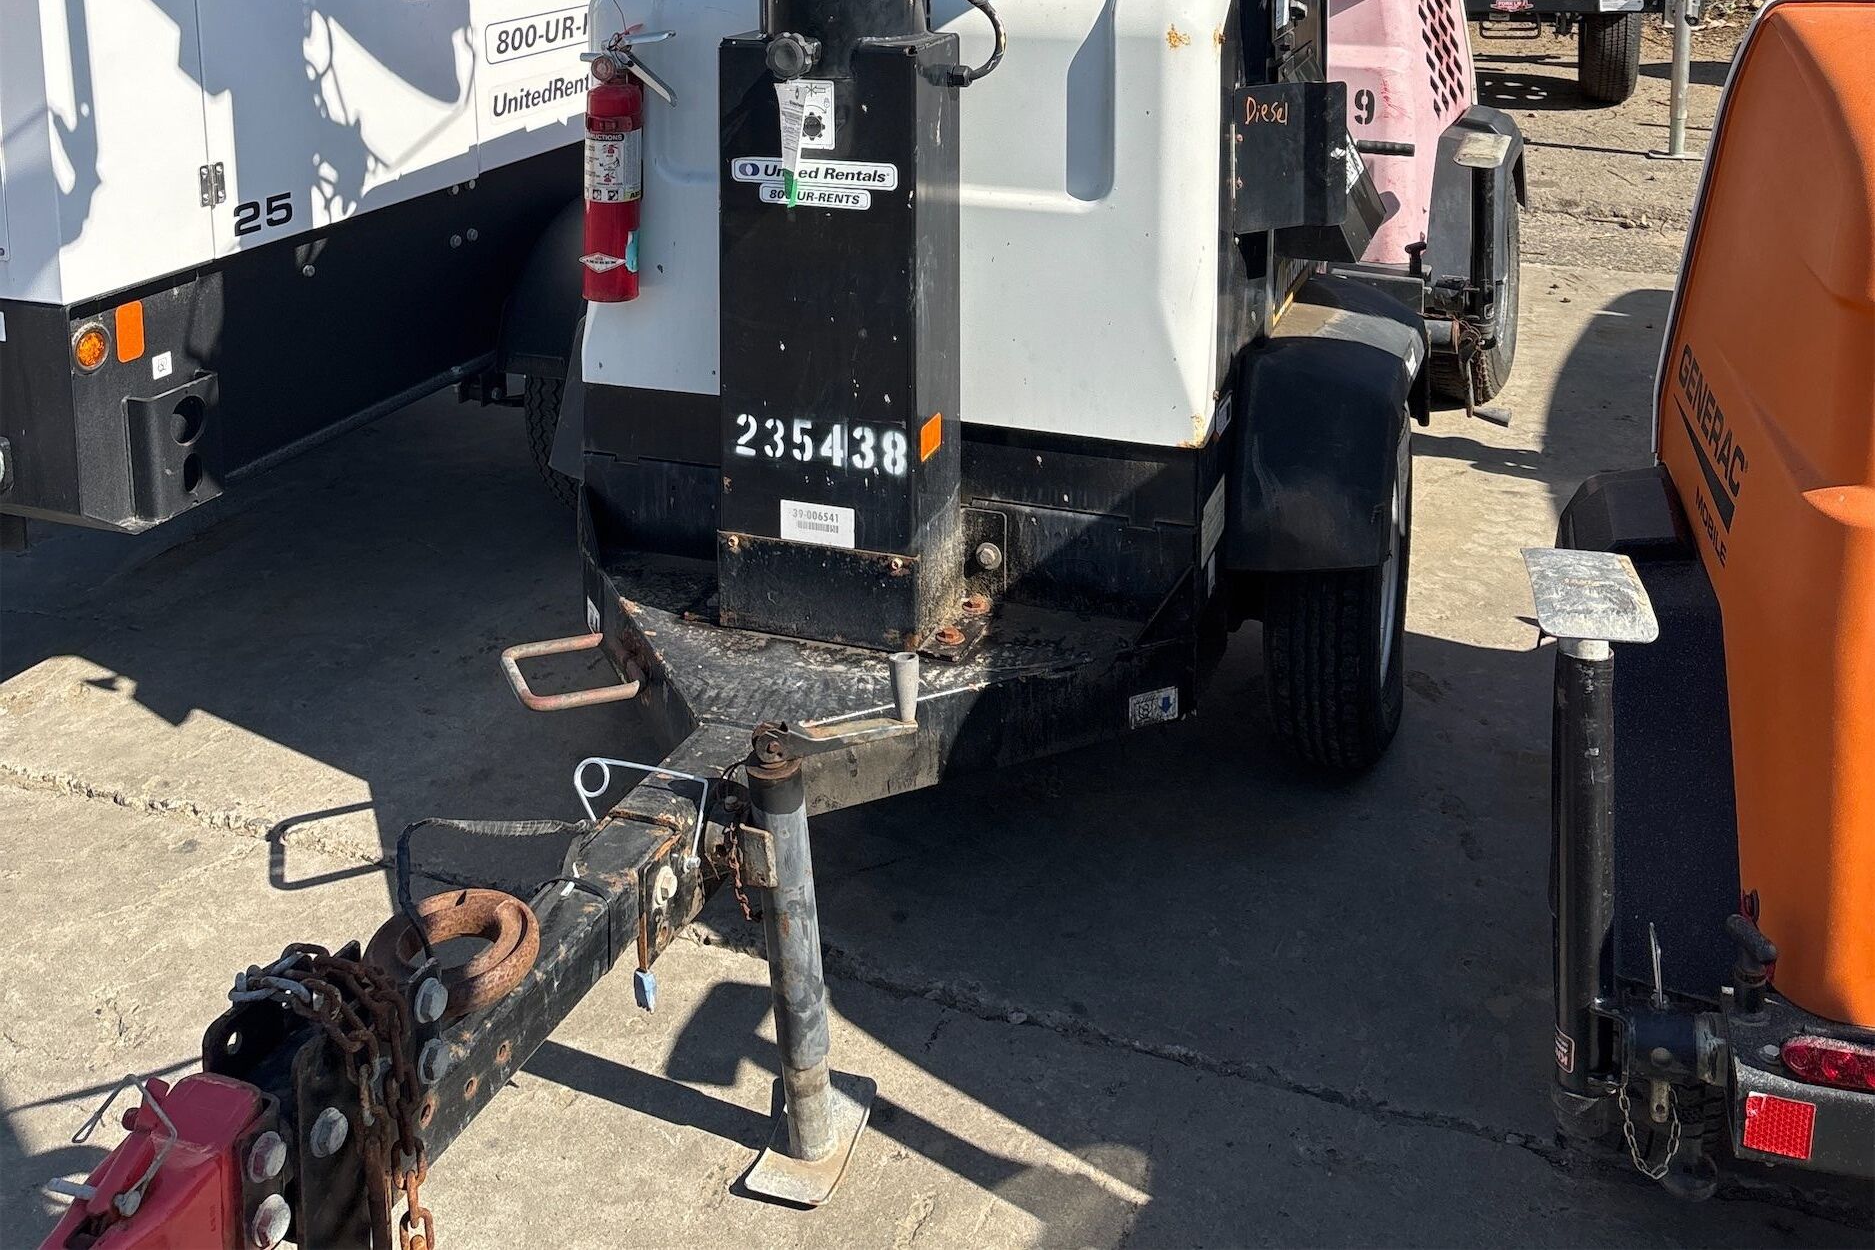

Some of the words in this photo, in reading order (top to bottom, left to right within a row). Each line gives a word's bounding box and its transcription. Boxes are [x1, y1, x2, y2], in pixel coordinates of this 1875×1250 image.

[1244, 96, 1289, 126] Diesel
[1354, 89, 1375, 125] 9
[764, 165, 819, 179] Uned
[824, 168, 886, 183] Rentals
[234, 192, 293, 237] 25
[769, 190, 860, 204] 80UR-RENTS
[1678, 344, 1745, 498] GENERAC
[735, 413, 908, 476] 235438
[793, 508, 840, 523] 39-006541
[1695, 485, 1727, 568] MOBILE
